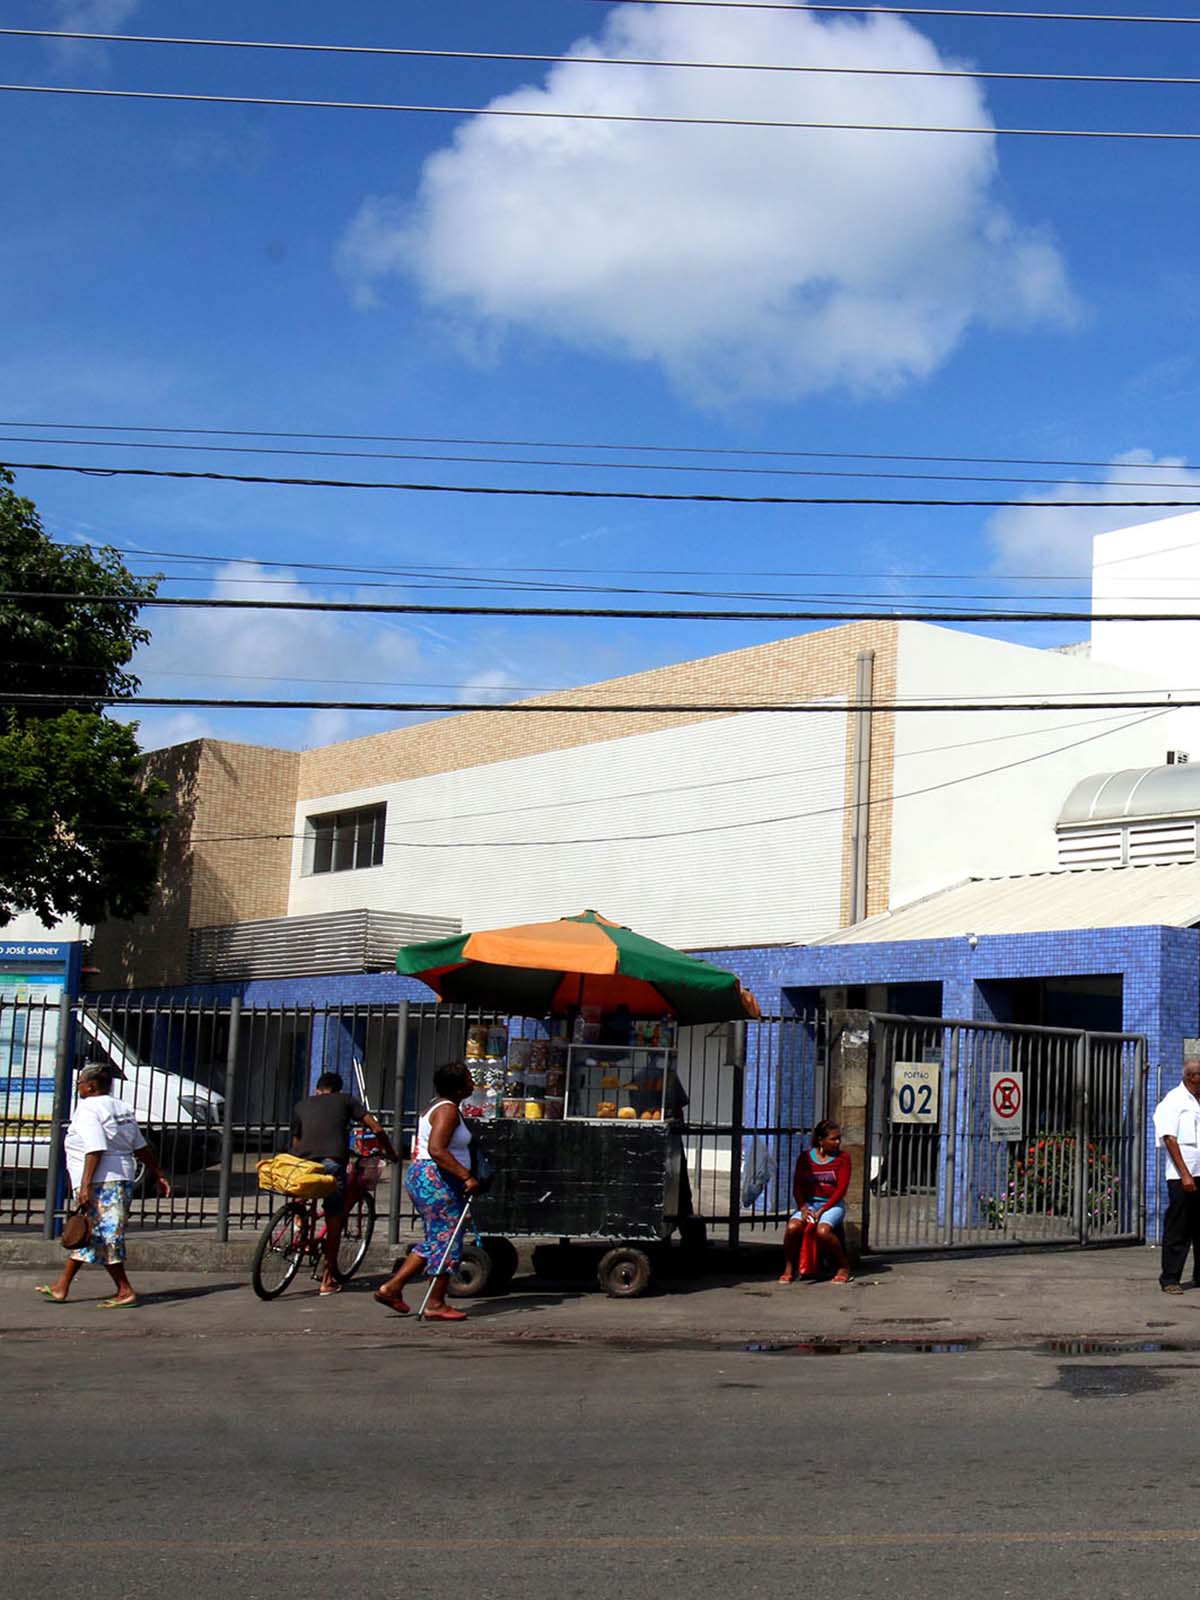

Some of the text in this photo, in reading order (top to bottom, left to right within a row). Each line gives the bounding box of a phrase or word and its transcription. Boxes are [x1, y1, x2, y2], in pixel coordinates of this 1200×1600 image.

[5, 945, 27, 955] JOSÉ
[27, 947, 59, 955] SARNEY
[898, 1084, 932, 1114] 02
